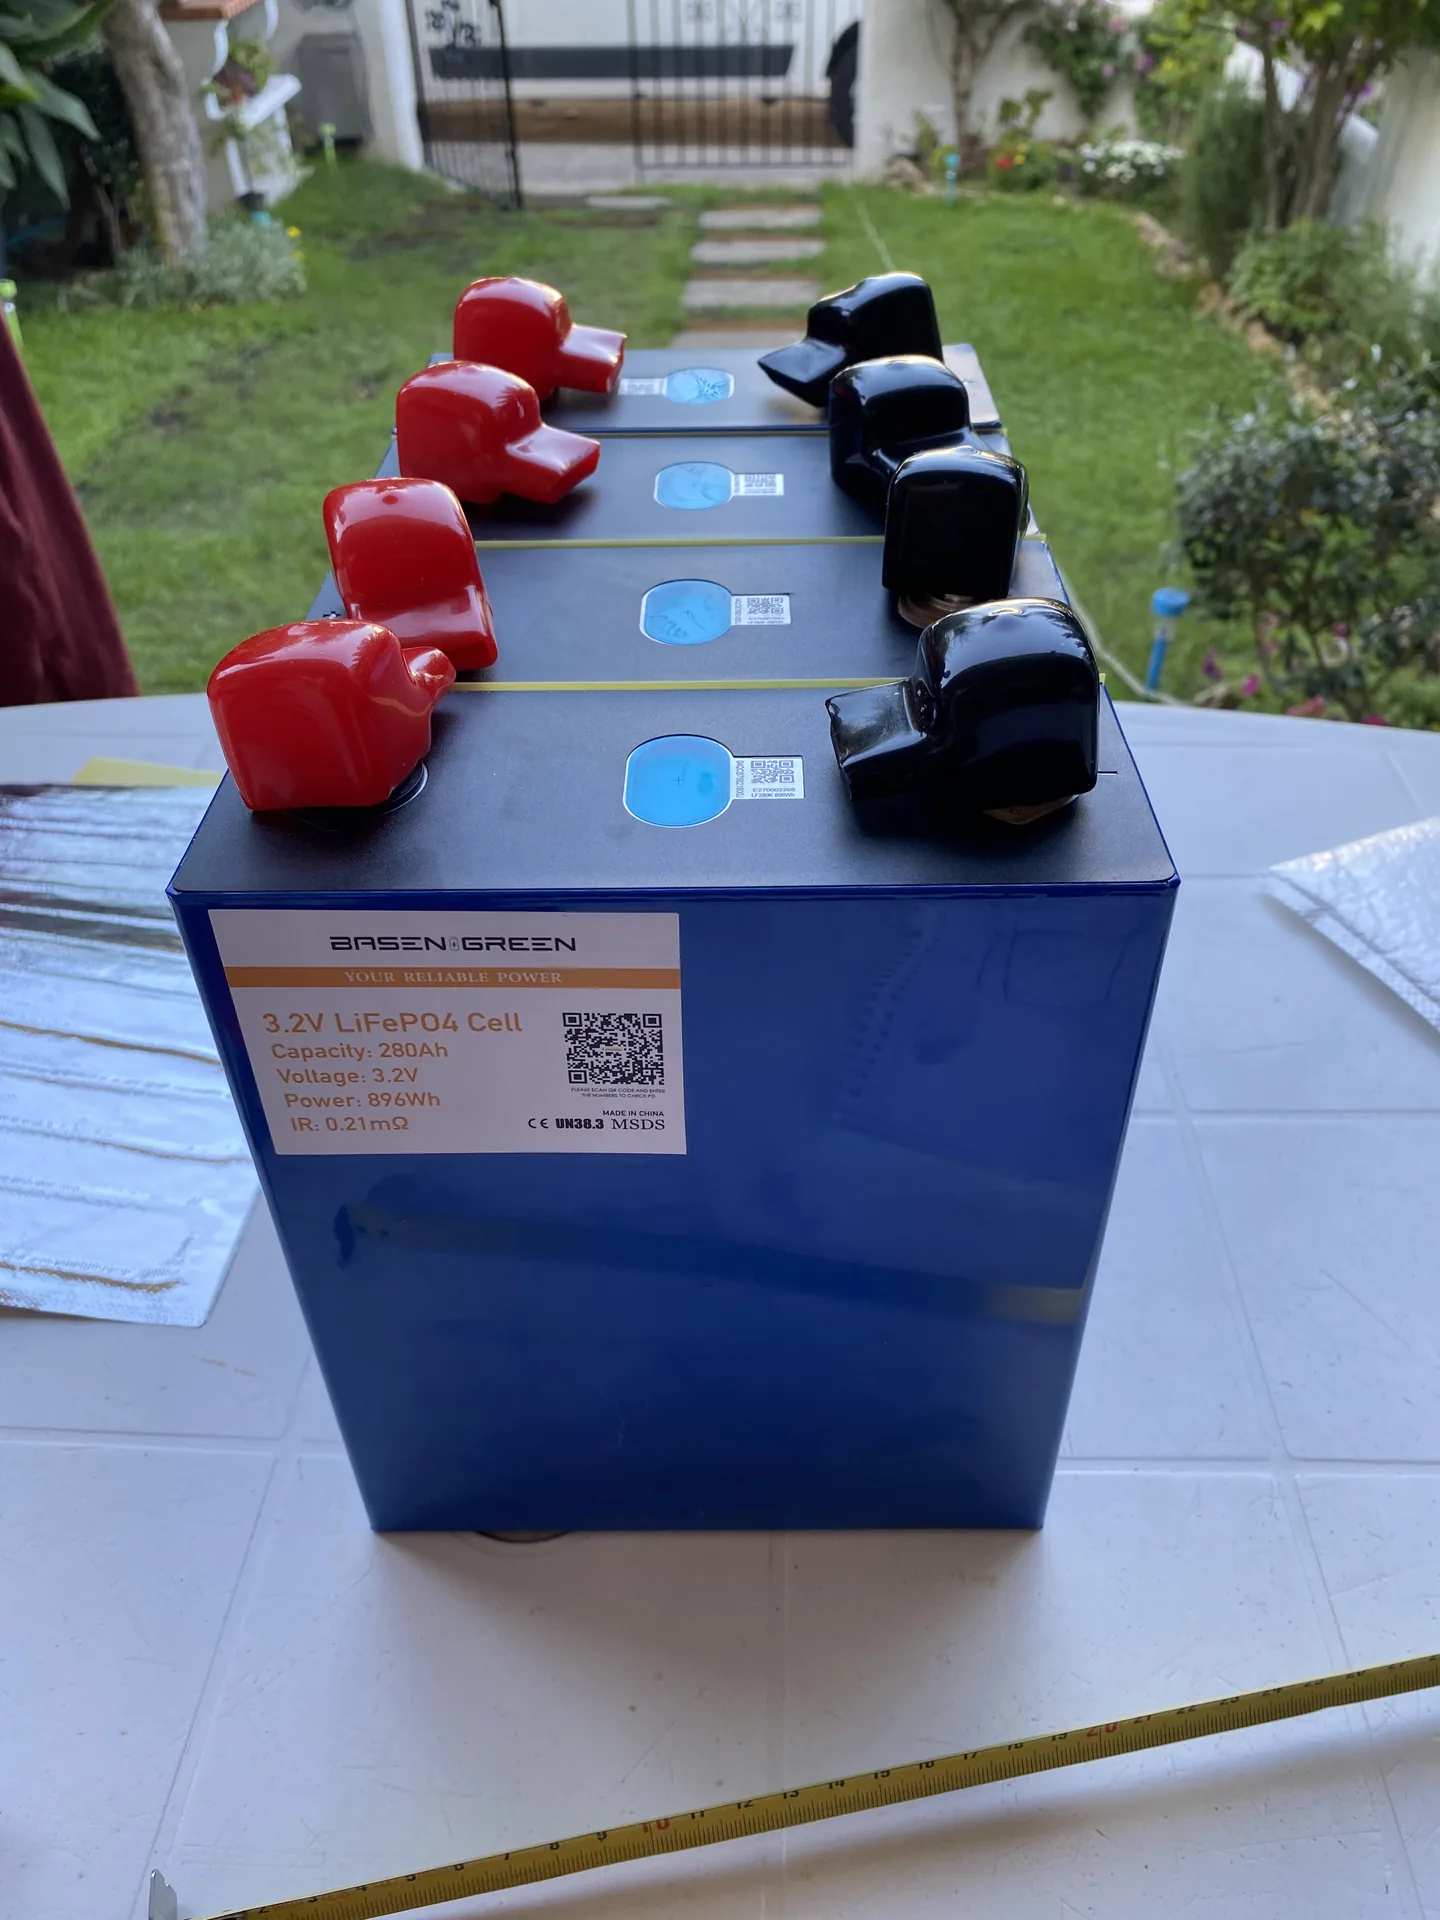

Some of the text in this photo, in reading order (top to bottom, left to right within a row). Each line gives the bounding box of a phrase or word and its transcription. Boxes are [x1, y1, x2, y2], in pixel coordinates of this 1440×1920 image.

[329, 936, 576, 951] BASEN GREEN
[344, 971, 563, 983] YOUR RELIABLE POWER
[262, 1012, 523, 1034] 3.2V LiFePO4 Cell
[271, 1042, 448, 1062] Capacity: 280Ah
[276, 1067, 418, 1087] Voltage: 3.2V
[284, 1092, 441, 1108] Power: 896Wh
[290, 1117, 320, 1131] IR:
[555, 1118, 604, 1130] UN38.3
[611, 1118, 665, 1130] MSDS
